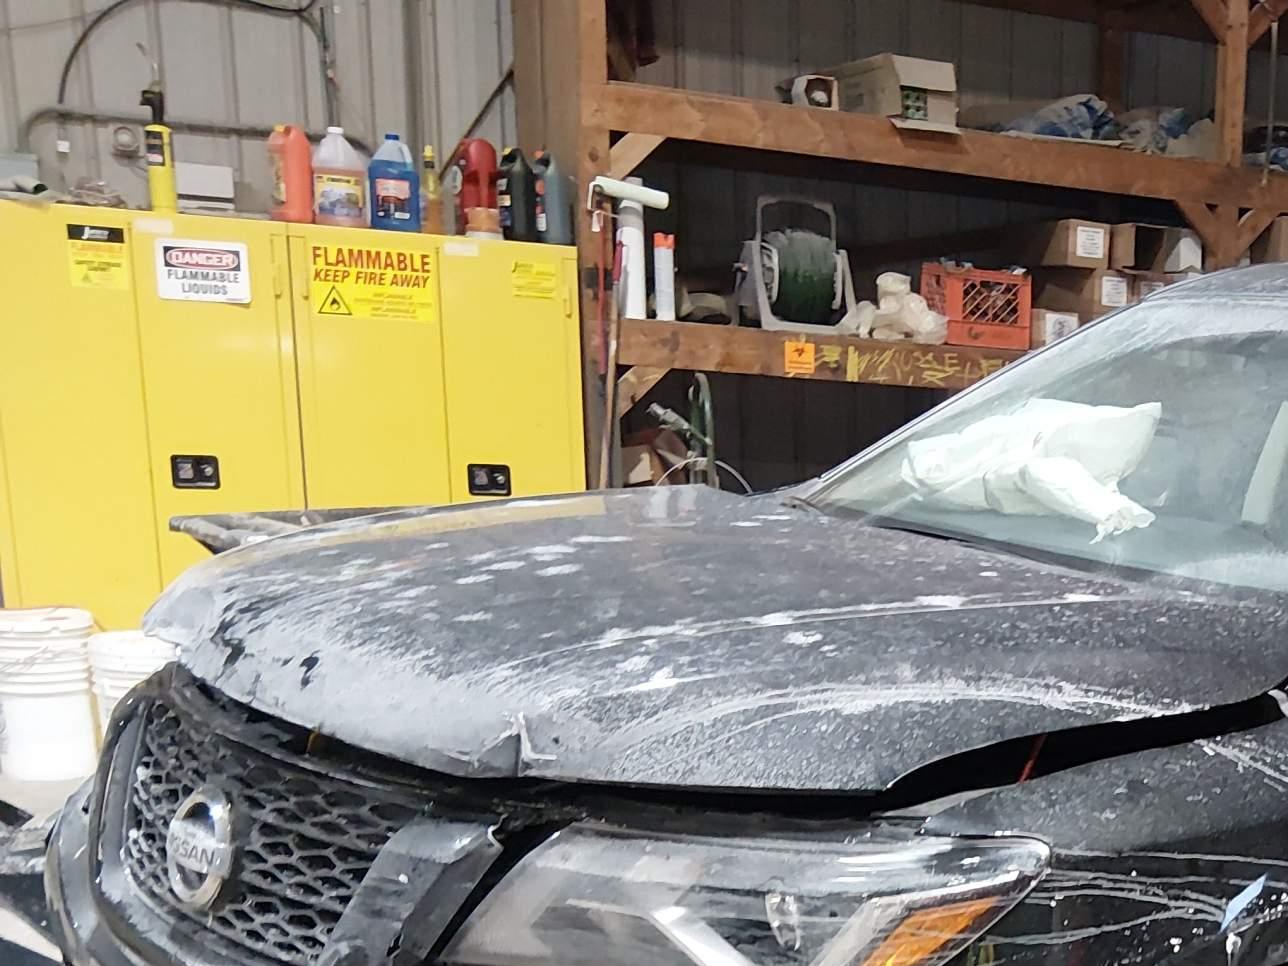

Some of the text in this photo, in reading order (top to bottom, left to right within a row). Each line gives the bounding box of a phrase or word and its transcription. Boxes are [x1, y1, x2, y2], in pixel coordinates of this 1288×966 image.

[171, 250, 233, 267] DANGER
[312, 246, 431, 273] FLAMMABLE
[167, 269, 239, 284] FLAMMABLE
[313, 268, 430, 288] KEEP FIRE AWAY
[181, 283, 228, 295] LIQUIDS
[169, 832, 214, 865] SSAN
